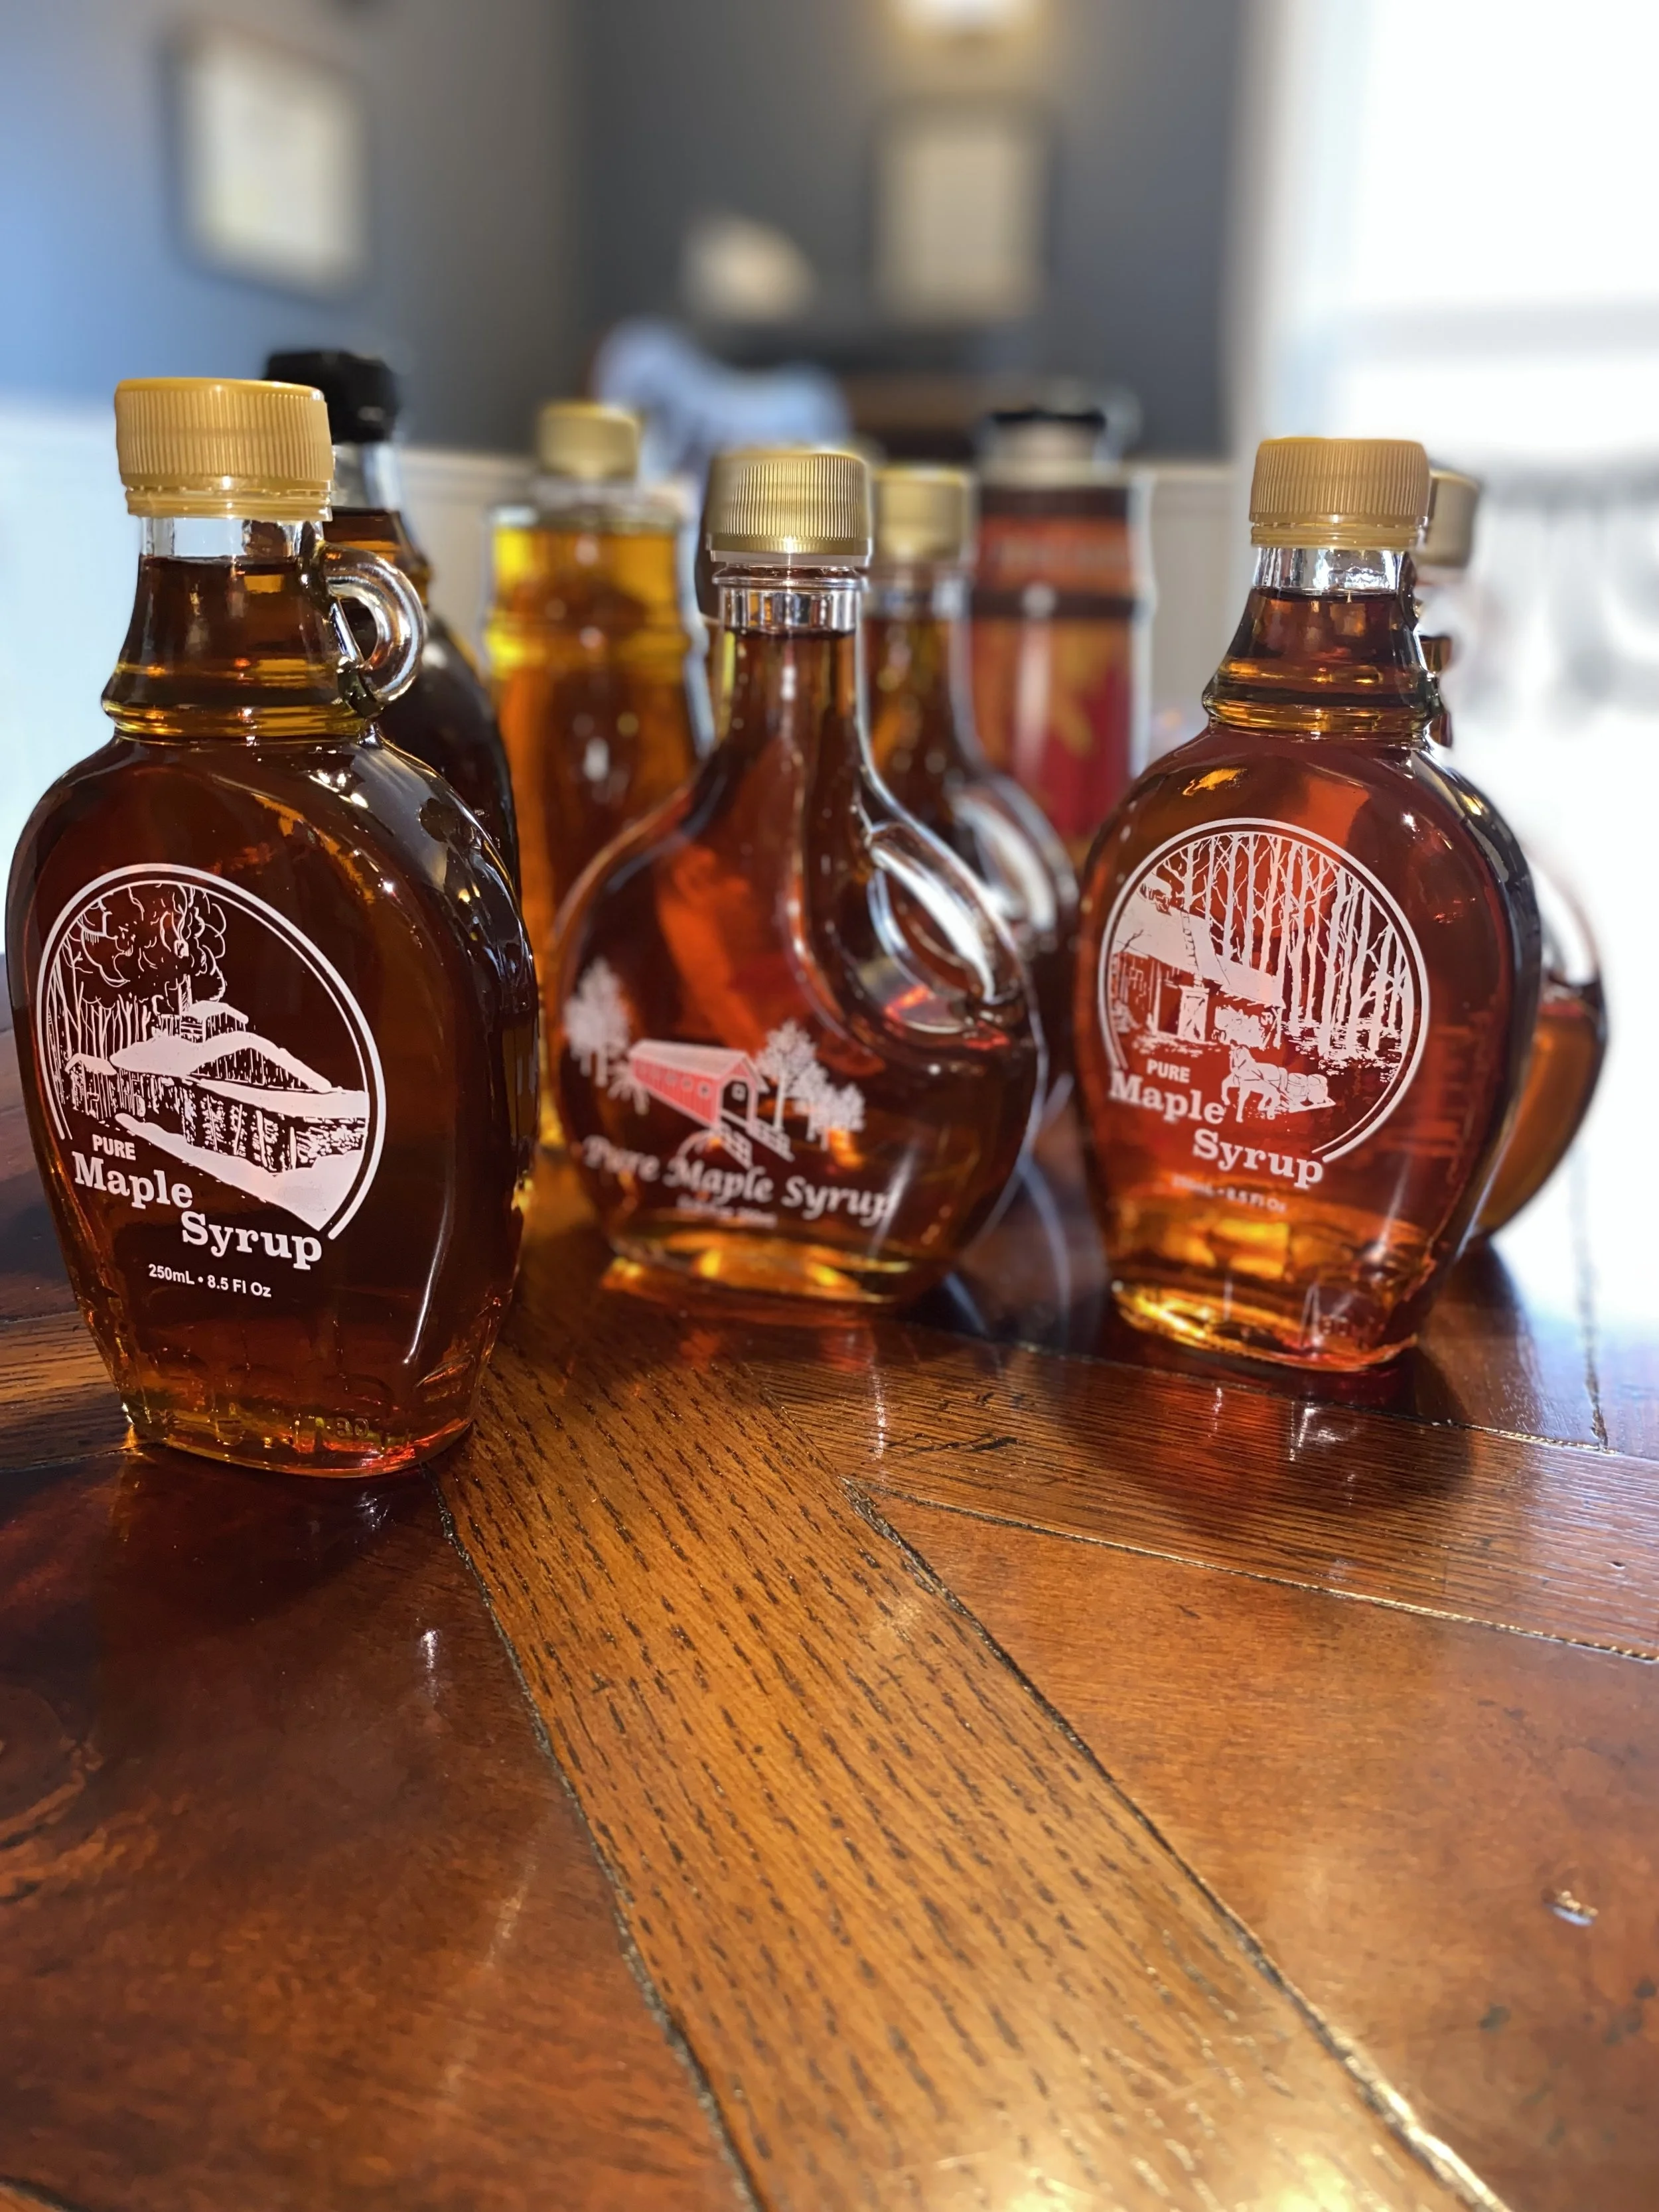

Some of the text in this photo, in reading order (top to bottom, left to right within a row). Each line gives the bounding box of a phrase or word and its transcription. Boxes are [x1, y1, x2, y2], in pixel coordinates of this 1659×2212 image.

[1109, 1070, 1225, 1124] Maple
[1146, 1059, 1190, 1083] PURE
[92, 1134, 136, 1160] PURE
[1192, 1128, 1323, 1190] Syrup
[72, 1151, 193, 1209] Maple
[583, 1136, 660, 1181] Pure
[664, 1157, 774, 1204] Maple
[781, 1175, 891, 1226] Syrup
[181, 1210, 322, 1270] Syrup
[149, 1263, 271, 1297] 250mL 8.5 Fl Oz
